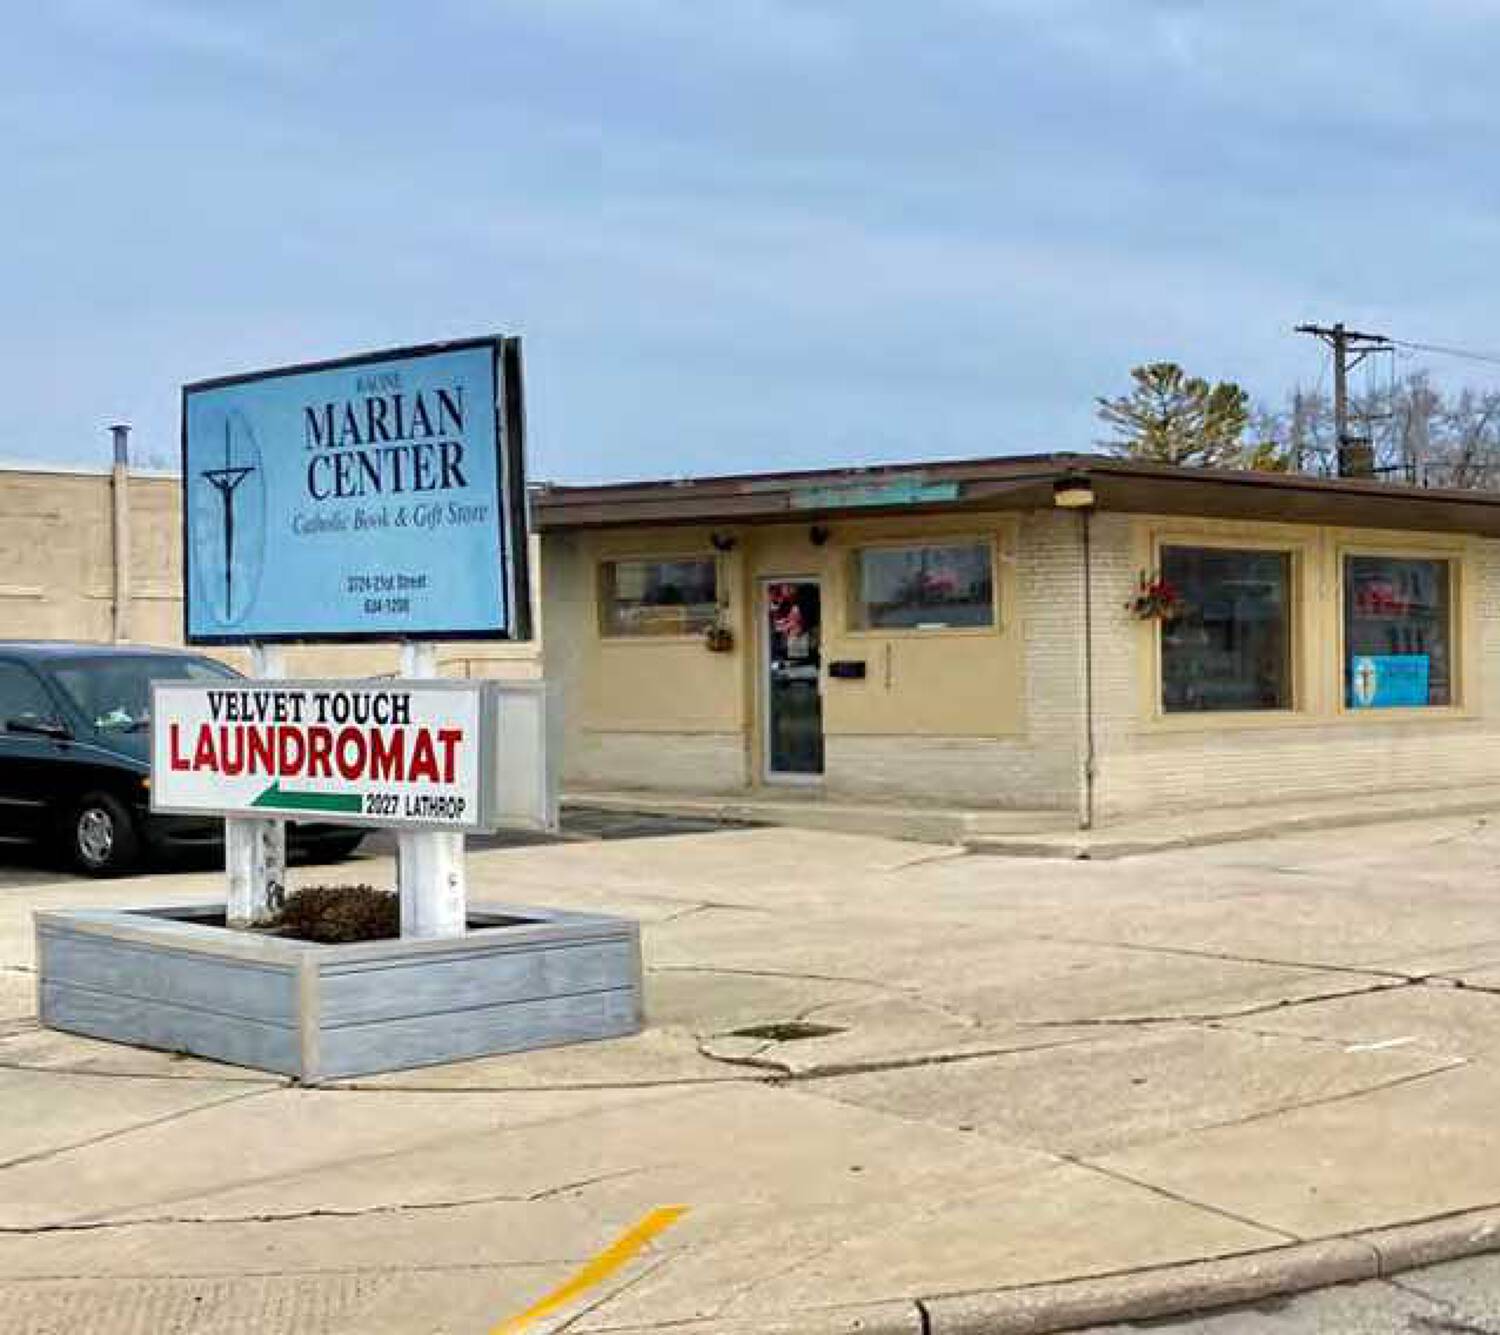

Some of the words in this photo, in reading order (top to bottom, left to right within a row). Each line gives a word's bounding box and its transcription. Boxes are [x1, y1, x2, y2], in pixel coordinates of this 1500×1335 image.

[304, 385, 466, 449] MARIAN
[306, 441, 469, 501] CENTER
[354, 506, 390, 529] Book
[394, 506, 410, 527] &
[413, 503, 443, 530] Gift
[448, 502, 490, 526] Store
[207, 691, 306, 723] VELVET
[313, 692, 412, 725] TOUCH
[168, 723, 463, 784] LAUNDROMAT
[365, 794, 399, 814] 2027
[405, 795, 467, 819] LATHROP
